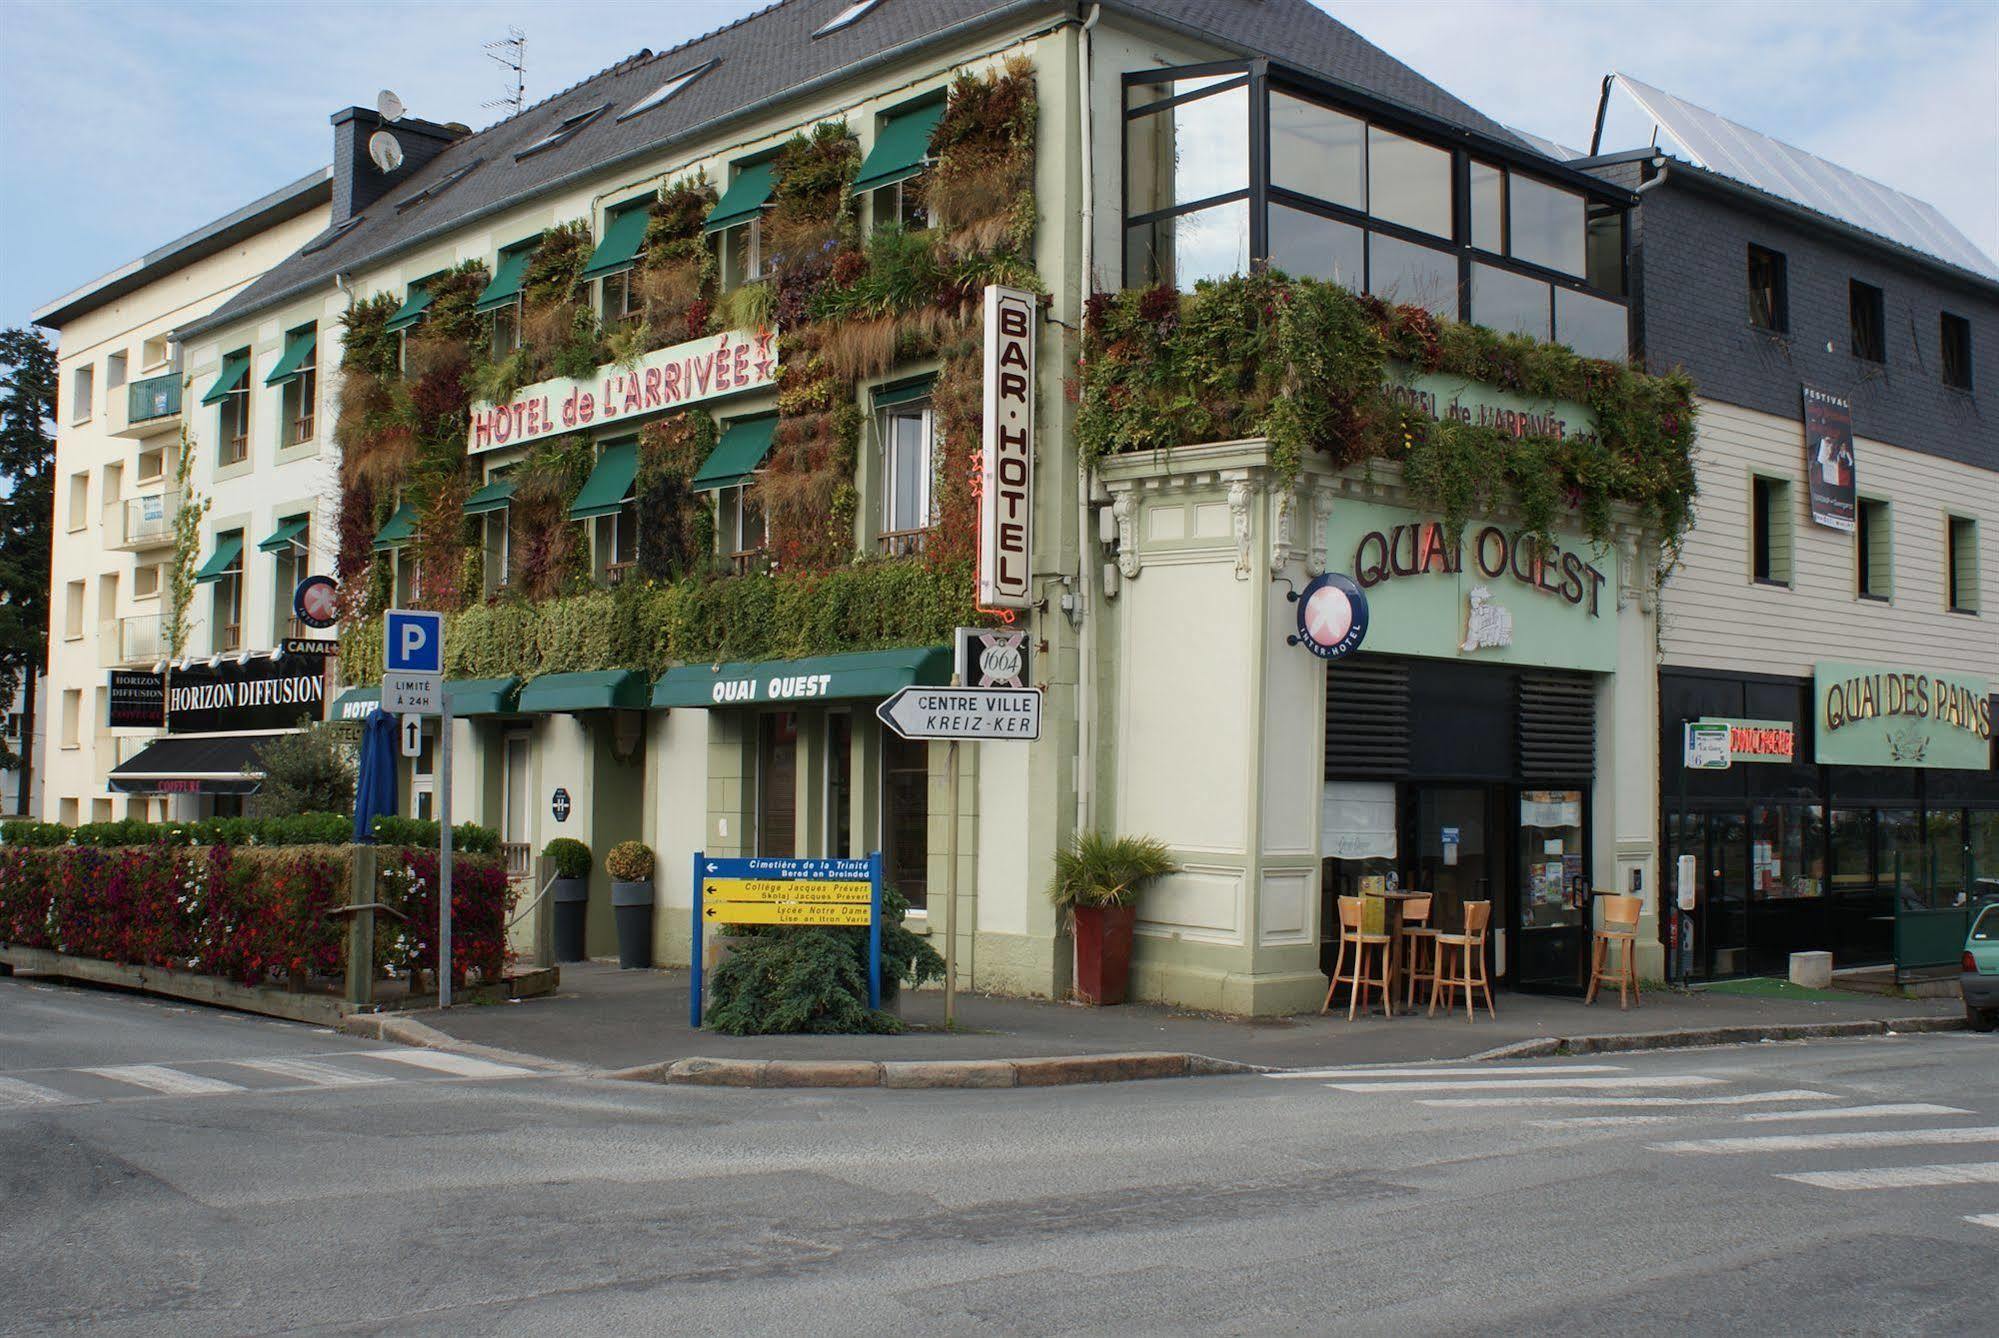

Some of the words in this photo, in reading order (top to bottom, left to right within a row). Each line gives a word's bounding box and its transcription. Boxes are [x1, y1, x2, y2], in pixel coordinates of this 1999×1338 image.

[475, 395, 553, 449] HOTEL
[563, 386, 594, 427] de
[604, 334, 750, 418] L'ARRIVÉE
[1804, 388, 1849, 408] FESTIVAL
[999, 424, 1027, 585] HOTEL
[1355, 522, 1462, 588] QUAI
[1477, 526, 1605, 618] OUEST
[401, 623, 427, 661] P
[1300, 624, 1361, 656] INTER-HOTEL
[287, 641, 340, 654] CANAL+
[983, 650, 1019, 673] 1664
[115, 676, 161, 685] HORIZON
[396, 681, 431, 692] LIMITÉ
[112, 688, 163, 698] DIFFUSION
[170, 683, 235, 712] HORIZON
[238, 675, 324, 707] DIFFUSION
[712, 680, 757, 703] QUAI
[768, 675, 831, 699] OUEST
[409, 697, 430, 706] 24H
[918, 697, 977, 711] CENTRE
[987, 698, 1031, 712] VILLE
[1826, 674, 1881, 731] QUAI
[1887, 673, 1929, 718] DES
[1933, 679, 1991, 740] PAINS
[343, 701, 379, 719] HOTE
[158, 780, 200, 792] COIFFURE
[749, 860, 797, 870] Cimetière
[803, 860, 814, 869] de
[820, 860, 829, 869] la
[837, 860, 869, 870] Trinité
[781, 870, 808, 878] Bered
[828, 870, 869, 878] Dreinded
[745, 883, 781, 892] Collège
[788, 883, 826, 892] Jacques
[833, 883, 869, 892] Prévert
[761, 893, 790, 901] Skolaj
[795, 893, 831, 901] Jacques
[777, 906, 802, 915] Lycée
[809, 906, 835, 914] Notre
[842, 906, 868, 915] Dame
[846, 915, 869, 923] Varia
